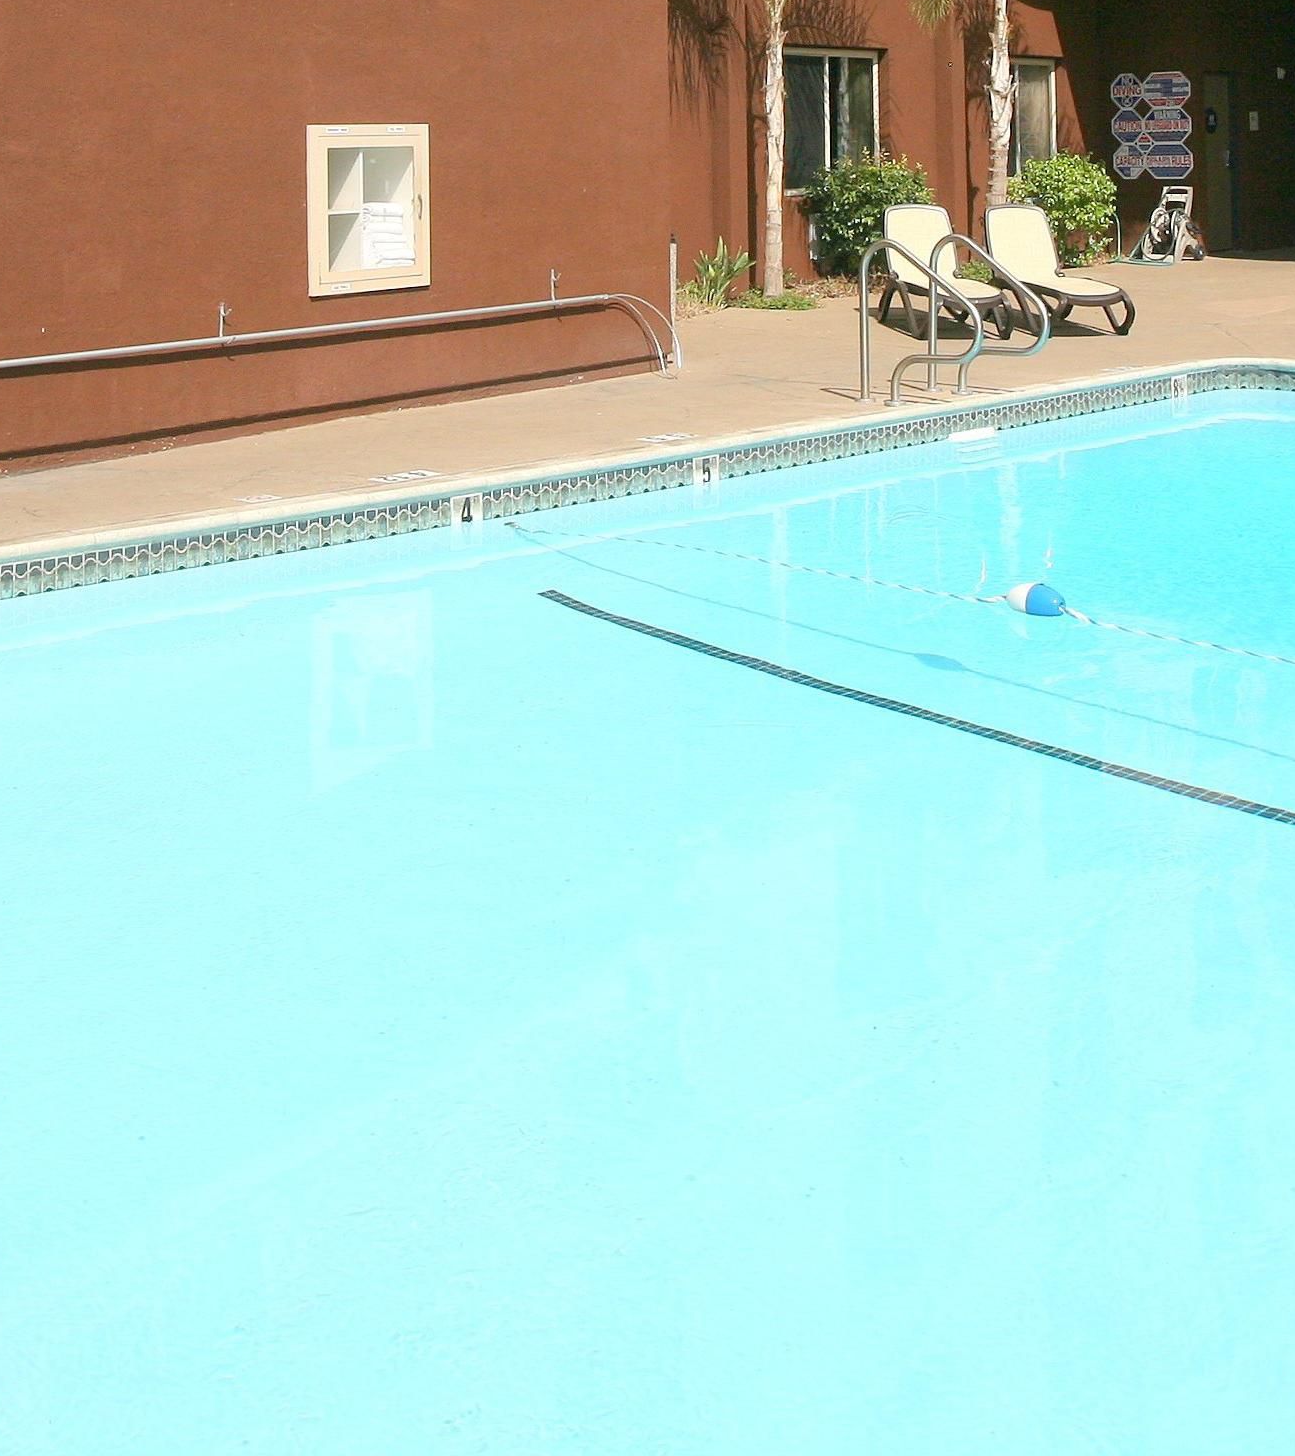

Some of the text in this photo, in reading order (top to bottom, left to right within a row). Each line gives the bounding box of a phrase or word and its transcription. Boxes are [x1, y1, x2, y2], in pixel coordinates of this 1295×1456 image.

[1121, 76, 1133, 85] NO
[1113, 86, 1142, 97] DIVING
[702, 458, 711, 483] 5
[461, 497, 473, 523] 4
